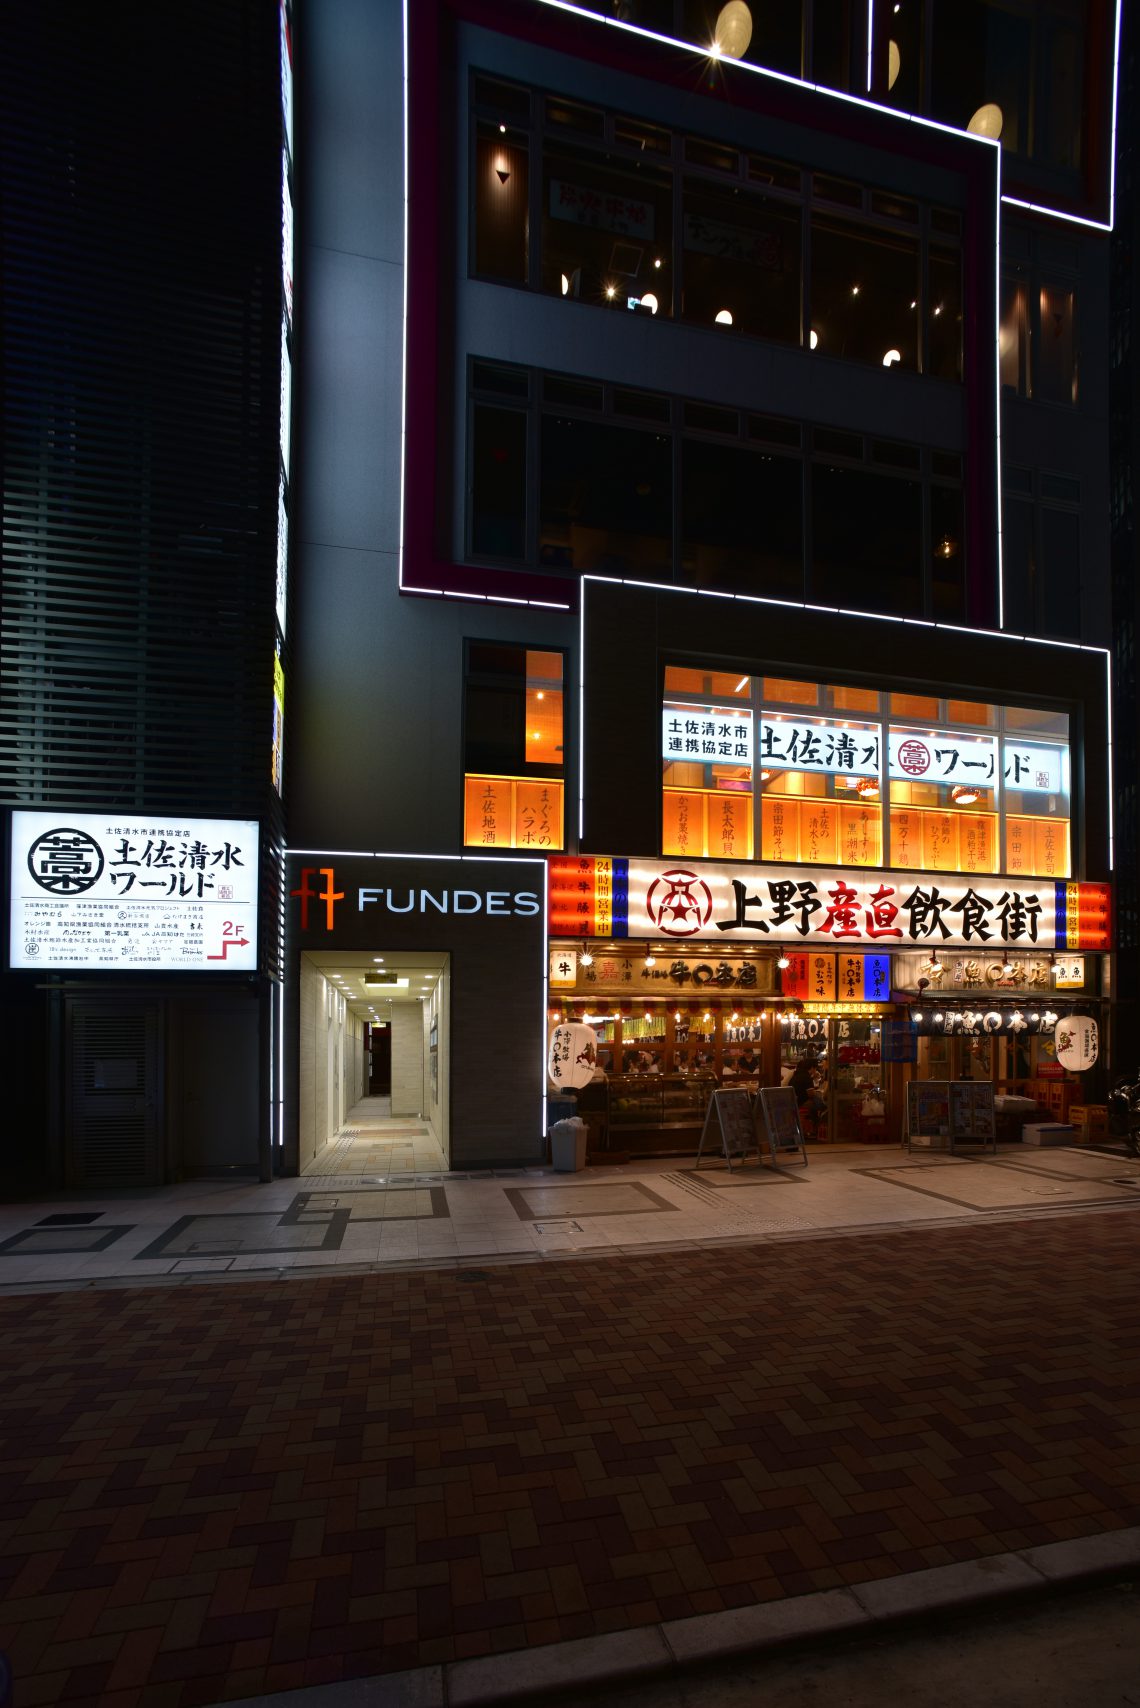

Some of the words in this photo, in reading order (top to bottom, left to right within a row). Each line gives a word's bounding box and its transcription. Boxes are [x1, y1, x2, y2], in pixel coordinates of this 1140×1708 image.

[668, 718, 748, 738] 土佐清水市
[668, 737, 749, 757] 連携協定店
[105, 827, 191, 838] 土佐清水市連携協定店
[481, 785, 497, 844] 土佐地酒
[522, 807, 537, 844] ハラボ
[538, 788, 552, 846] まぐろの
[721, 800, 735, 856] 長太郎貝
[773, 802, 784, 861] 宗田節そば
[819, 808, 830, 838] 土佐の
[108, 838, 245, 871] 土佐清水
[809, 817, 820, 861] 清水さば
[846, 823, 858, 863] 黒潮米
[1010, 825, 1023, 871] 宗田節
[1044, 826, 1055, 875] 土佐寿司
[109, 871, 216, 898] ワールド
[358, 888, 541, 916] FUNDES
[597, 861, 610, 934] 24時間営業中
[222, 920, 245, 936] 2F
[715, 879, 1043, 943] 上野産直飲食街
[1068, 886, 1077, 947] 24時間営業中
[558, 961, 572, 977] 牛
